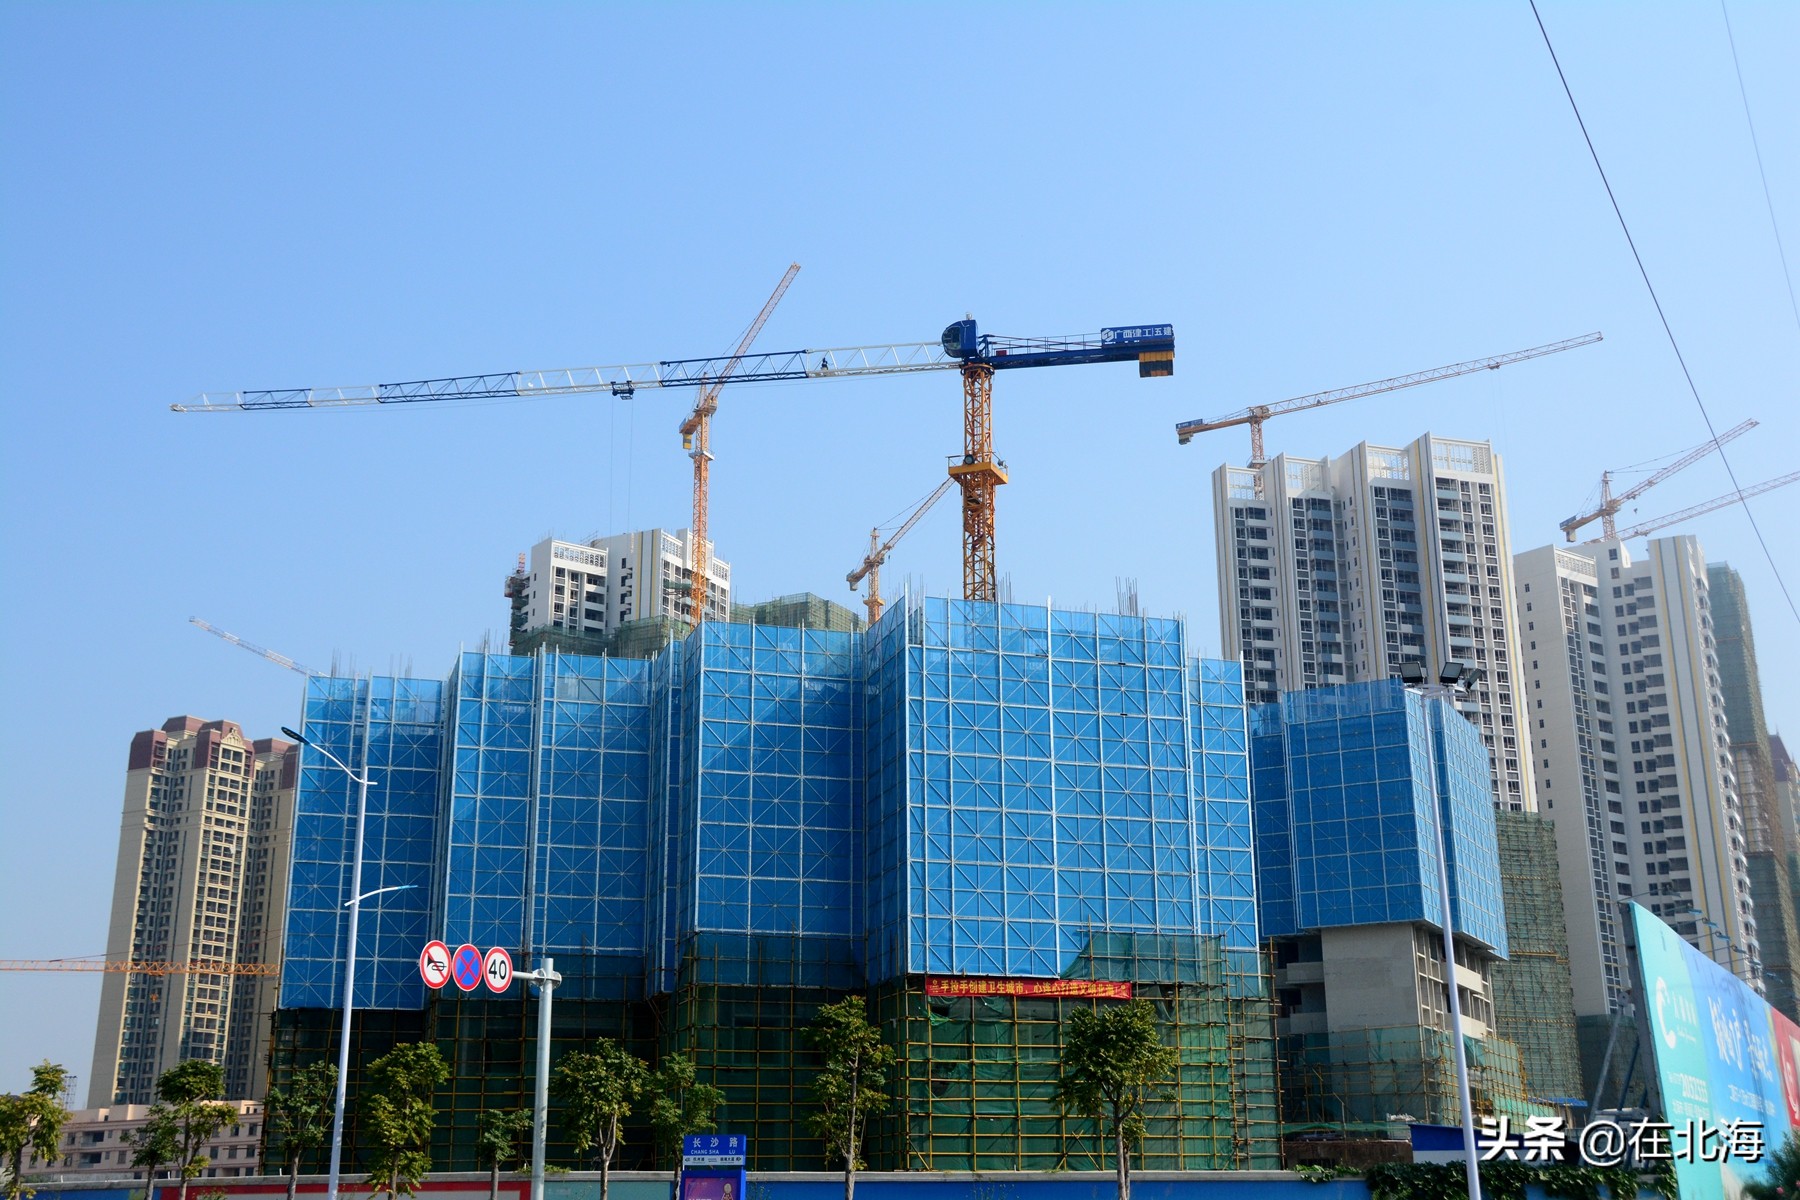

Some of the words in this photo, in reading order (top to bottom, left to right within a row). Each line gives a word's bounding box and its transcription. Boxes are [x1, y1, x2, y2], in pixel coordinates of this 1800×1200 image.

[488, 959, 507, 980] 40
[693, 1137, 738, 1148] 长沙路
